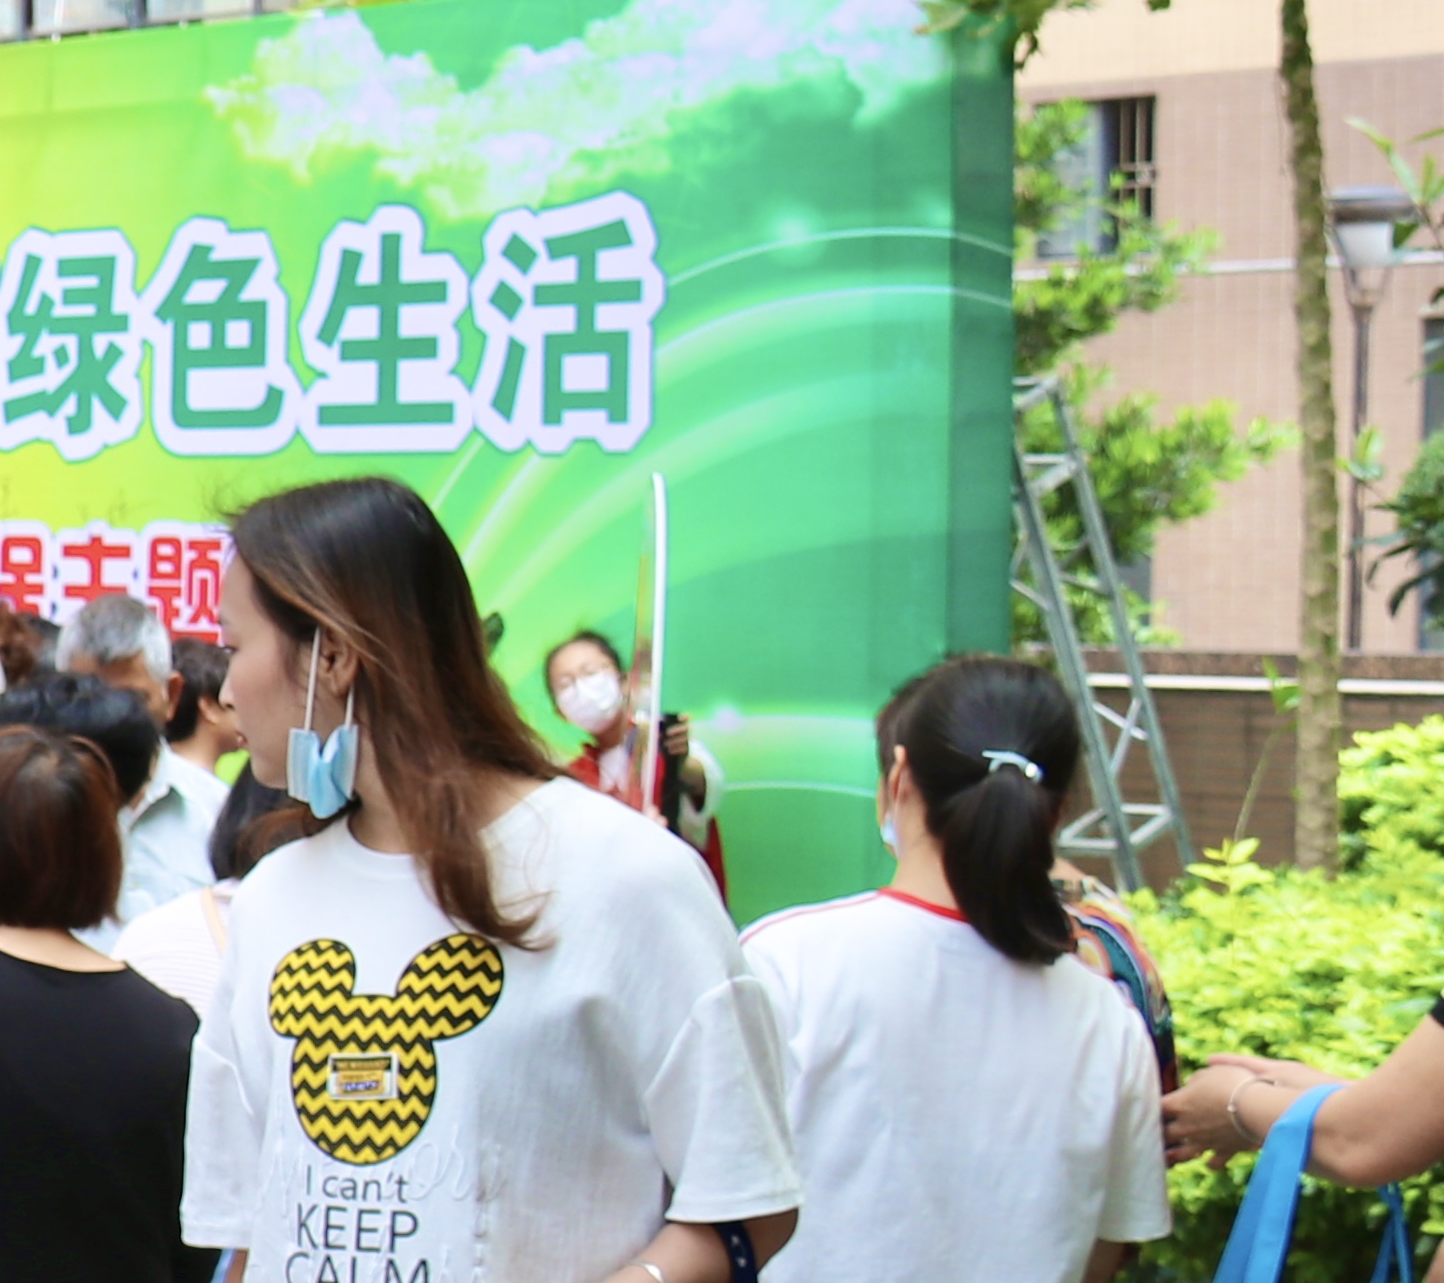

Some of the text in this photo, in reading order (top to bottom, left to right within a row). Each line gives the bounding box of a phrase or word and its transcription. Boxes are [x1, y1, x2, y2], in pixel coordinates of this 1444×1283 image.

[305, 1163, 409, 1204] I can't
[296, 1201, 420, 1254] KEEP
